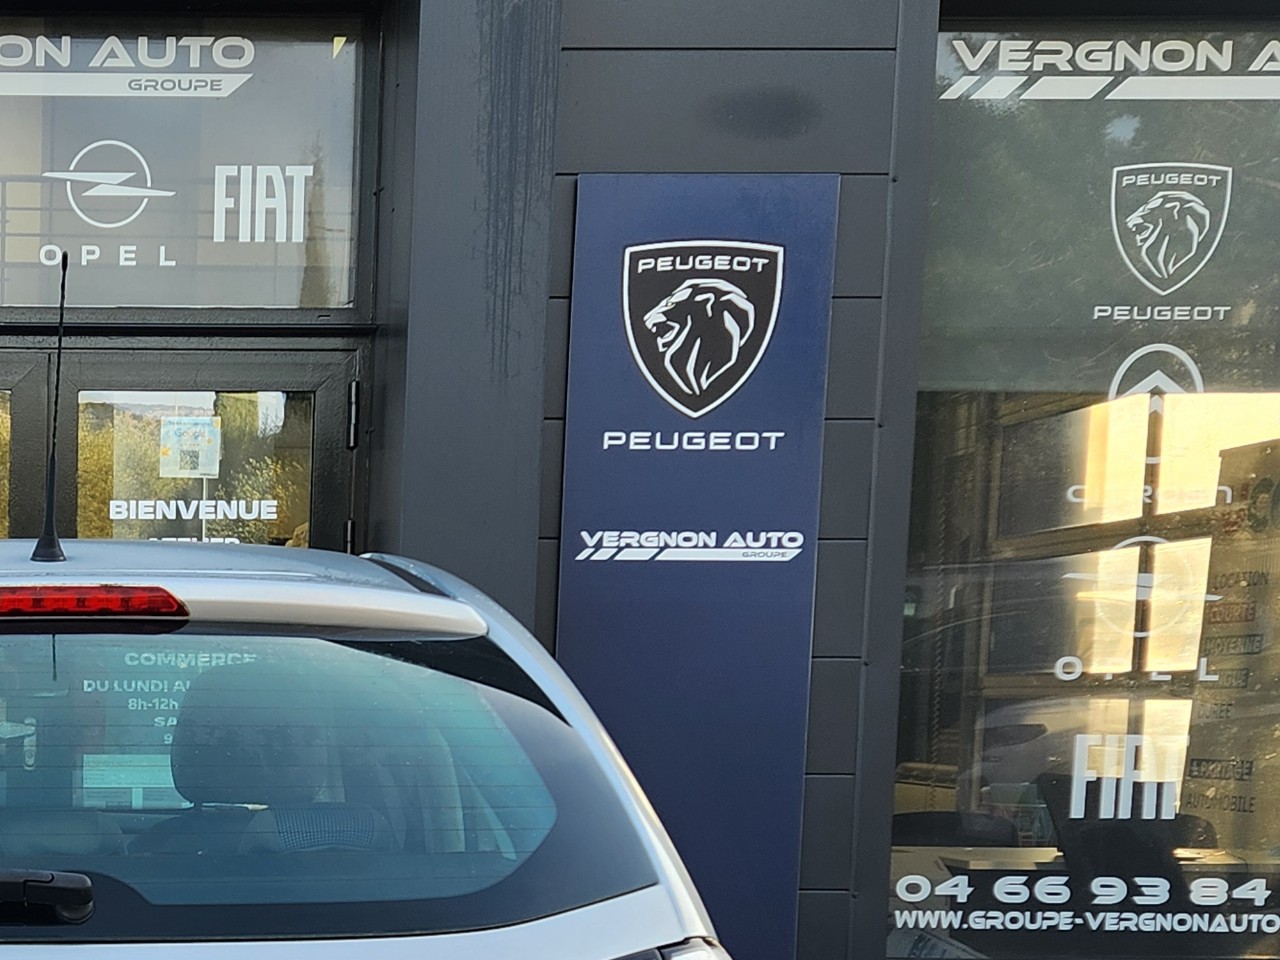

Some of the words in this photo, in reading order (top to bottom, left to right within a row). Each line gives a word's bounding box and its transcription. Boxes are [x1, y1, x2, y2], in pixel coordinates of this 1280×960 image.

[88, 35, 256, 68] AUTO
[952, 39, 1233, 72] VERGNON
[127, 78, 223, 92] GROUPE
[1121, 172, 1223, 189] PEUGEOT
[213, 165, 314, 242] FIAT
[39, 244, 177, 267] OPEL
[637, 254, 770, 274] PEUGEOT
[1092, 305, 1232, 322] PEUGEOT
[602, 431, 785, 452] PEUGEOT
[109, 500, 278, 520] BIENVENUE
[580, 530, 717, 548] VERGNON
[723, 531, 804, 548] AUTO
[83, 679, 109, 692] DU
[114, 679, 168, 692] LUNDI
[1069, 734, 1191, 820] FIAT
[895, 874, 975, 903] 04
[993, 875, 1071, 904] 66
[1091, 876, 1171, 905] 93
[1189, 877, 1272, 906] 84
[894, 909, 1280, 934] WWW.GROUPE-VERGNONAUTO
